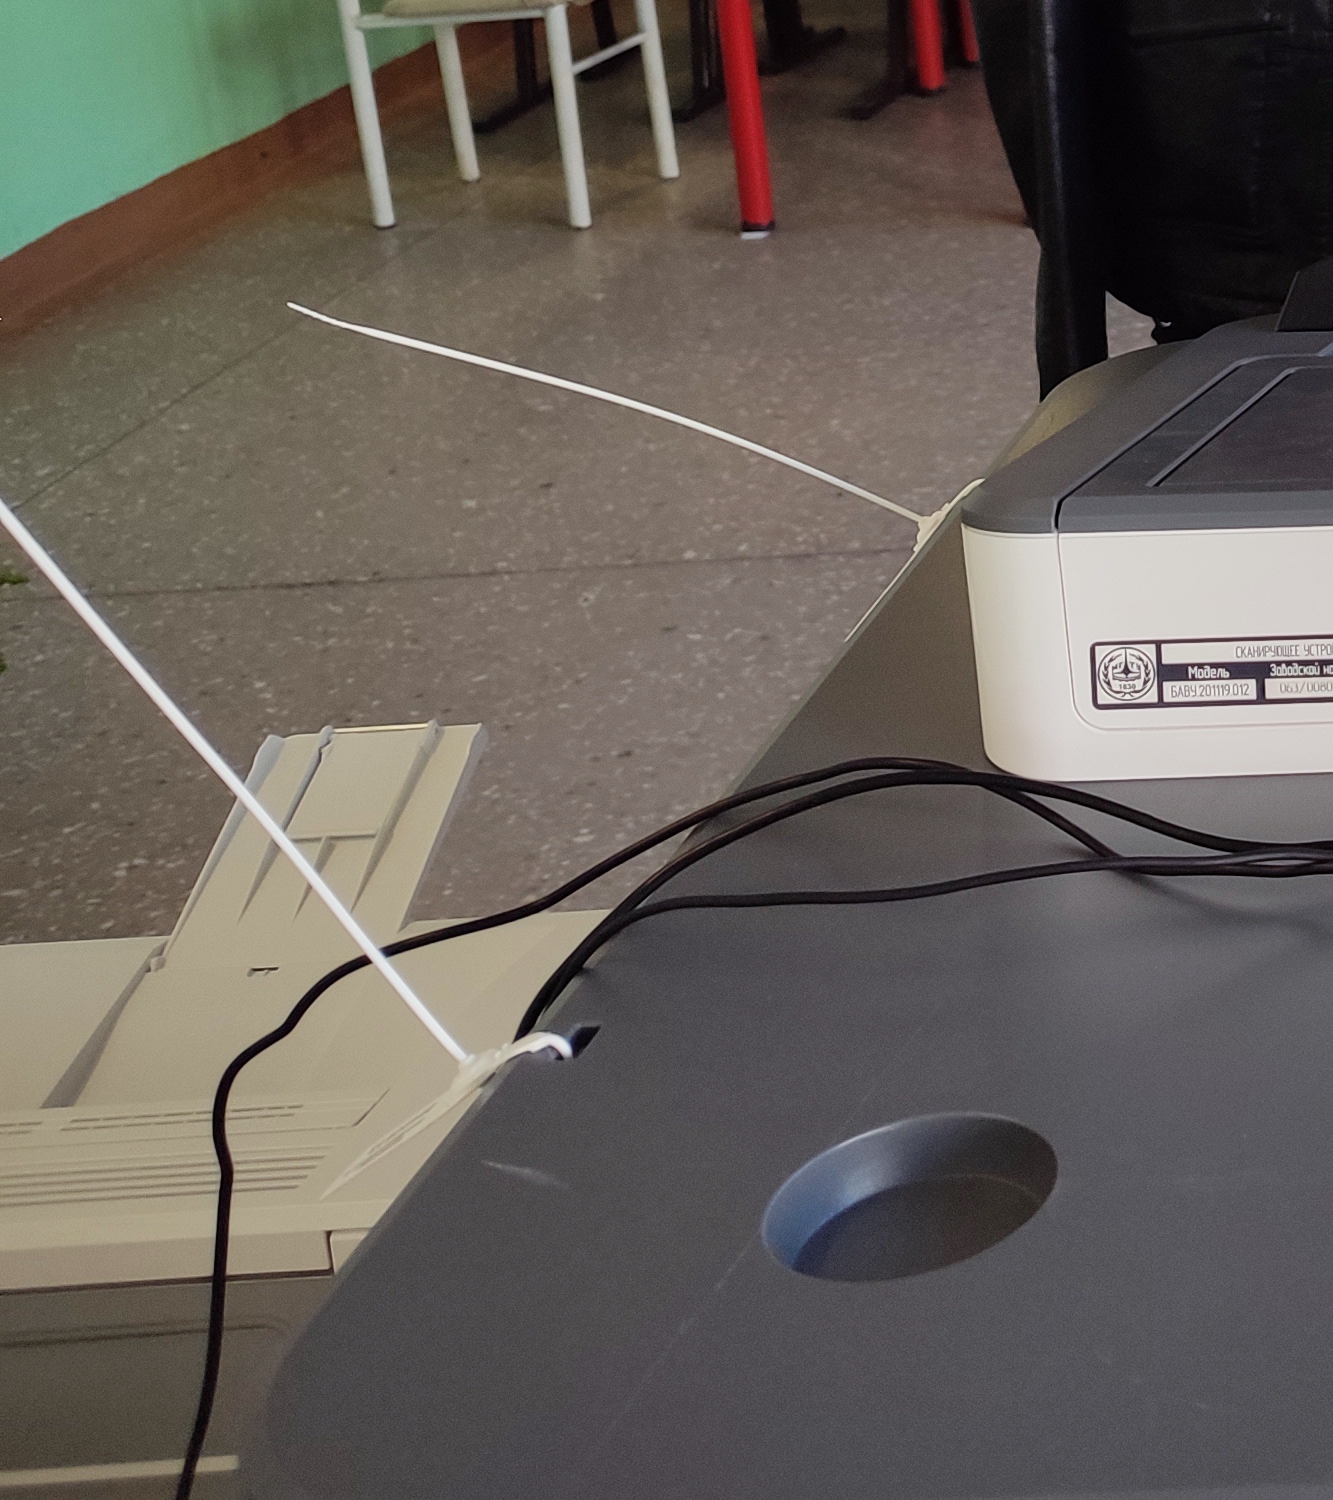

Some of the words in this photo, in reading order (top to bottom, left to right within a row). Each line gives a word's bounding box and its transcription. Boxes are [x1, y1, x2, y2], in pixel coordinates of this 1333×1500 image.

[1234, 642, 1301, 659] СКАНИРУЮЩЕЕ
[1187, 665, 1231, 680] Модель
[1269, 661, 1320, 677] Заводской
